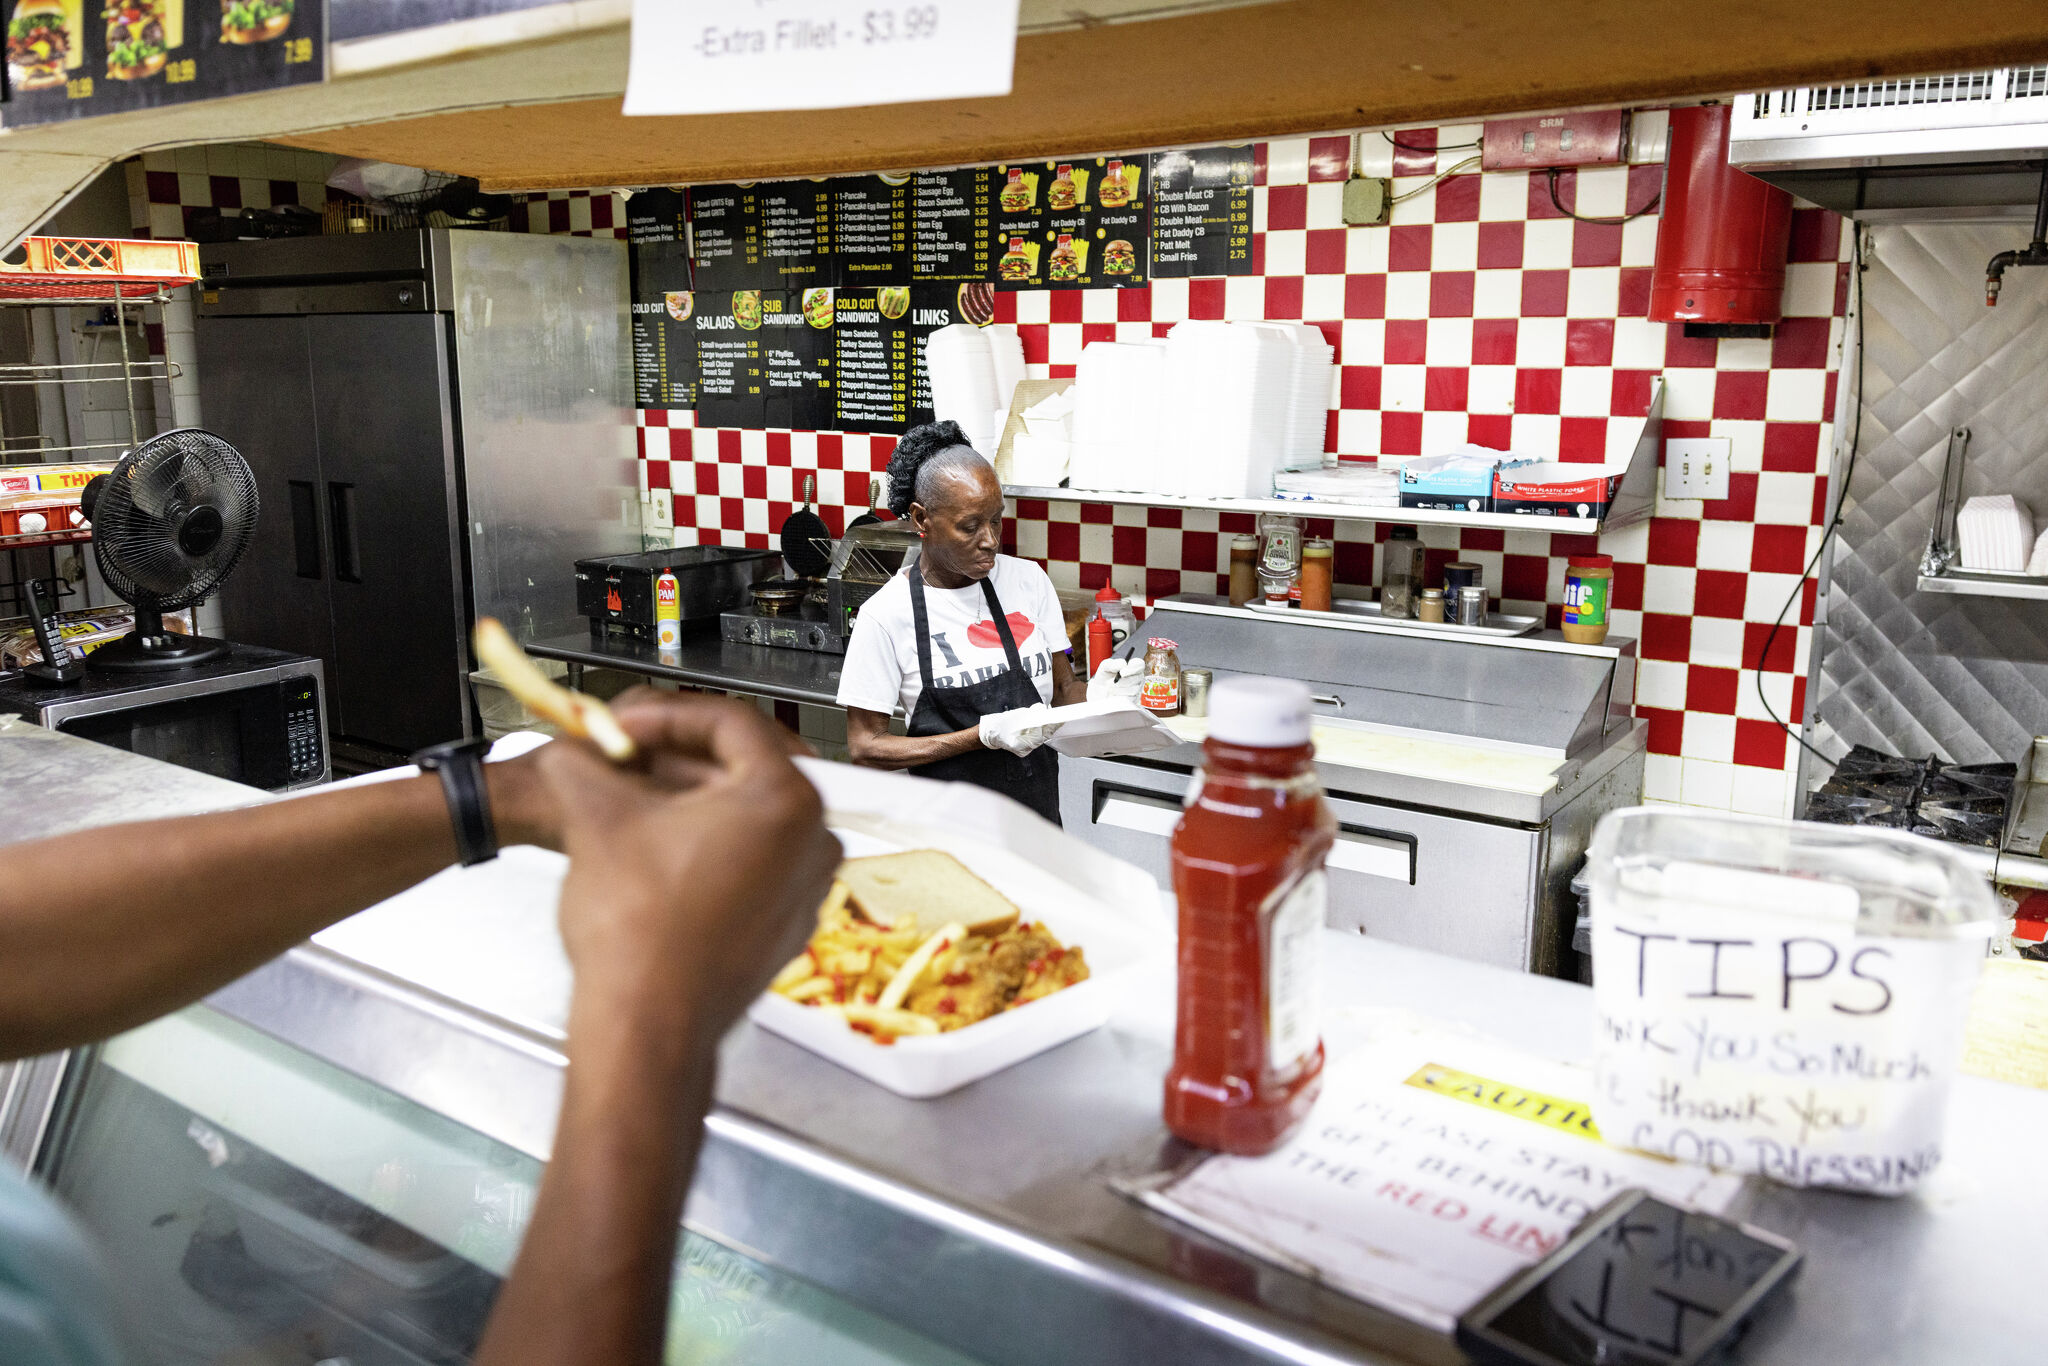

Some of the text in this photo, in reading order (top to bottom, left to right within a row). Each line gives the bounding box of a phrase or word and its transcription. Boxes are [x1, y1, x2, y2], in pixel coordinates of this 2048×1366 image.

[776, 19, 836, 51] Fillet
[865, 4, 940, 46] $3.99
[1540, 118, 1564, 128] SRM
[918, 177, 936, 185] Bacon
[936, 176, 947, 185] Egg
[1160, 181, 1170, 189] HB
[840, 192, 867, 200] 1-Pancake
[918, 188, 941, 196] Sausage
[943, 187, 953, 196] Egg
[976, 185, 988, 193] 5.54
[1160, 192, 1184, 201] Double
[1185, 191, 1202, 200] Meat
[1203, 190, 1214, 198] CB
[1231, 188, 1247, 197] 7.39
[840, 202, 867, 210] 1-Pancake
[1160, 205, 1170, 214] CB
[1171, 204, 1186, 212] With
[1187, 203, 1209, 212] Bacon
[1231, 200, 1247, 209] 6.99
[918, 210, 941, 218] Sausage
[942, 208, 970, 216] Sandwich
[975, 207, 988, 216] 5.25
[932, 220, 942, 229] Egg
[1111, 216, 1128, 224] Daddy
[1160, 217, 1184, 226] Double
[1184, 215, 1202, 224] Meat
[1231, 212, 1247, 222] 8.99
[1000, 222, 1016, 230] Double
[1160, 229, 1171, 238] Fat
[1172, 228, 1194, 238] Daddy
[1194, 227, 1205, 236] CB
[1232, 225, 1248, 234] 7.99
[918, 243, 936, 251] Turkey
[955, 242, 966, 251] Egg
[1160, 241, 1174, 250] Patt
[1175, 240, 1190, 249] Melt
[1230, 238, 1246, 246] 5.99
[1160, 252, 1179, 262] Small
[1180, 252, 1197, 261] Fries
[1230, 250, 1246, 259] 2.75
[914, 264, 920, 272] 10
[975, 263, 988, 271] 5.54
[632, 303, 664, 313] COLD CUT
[763, 300, 782, 312] SUB
[836, 298, 876, 309] COLD CUT
[763, 314, 804, 324] SANDWICH
[836, 312, 879, 323] SANDWICH
[912, 309, 949, 325] LINKS
[696, 316, 735, 330] SALADS
[853, 330, 878, 338] Sandwich
[841, 340, 857, 349] Turkey
[858, 340, 883, 348] Sandwich
[917, 337, 927, 345] Hot
[862, 361, 887, 369] Sandwich
[867, 392, 892, 400] Sandwich
[659, 589, 675, 600] PAM
[931, 632, 963, 668] I
[1614, 926, 1893, 1015] TIPS
[1769, 1031, 1823, 1074] So
[1512, 1149, 1628, 1190] STAY
[1417, 1156, 1593, 1214] BEHIND
[1375, 1181, 1470, 1222] RED
[1475, 1213, 1560, 1258] LIN
